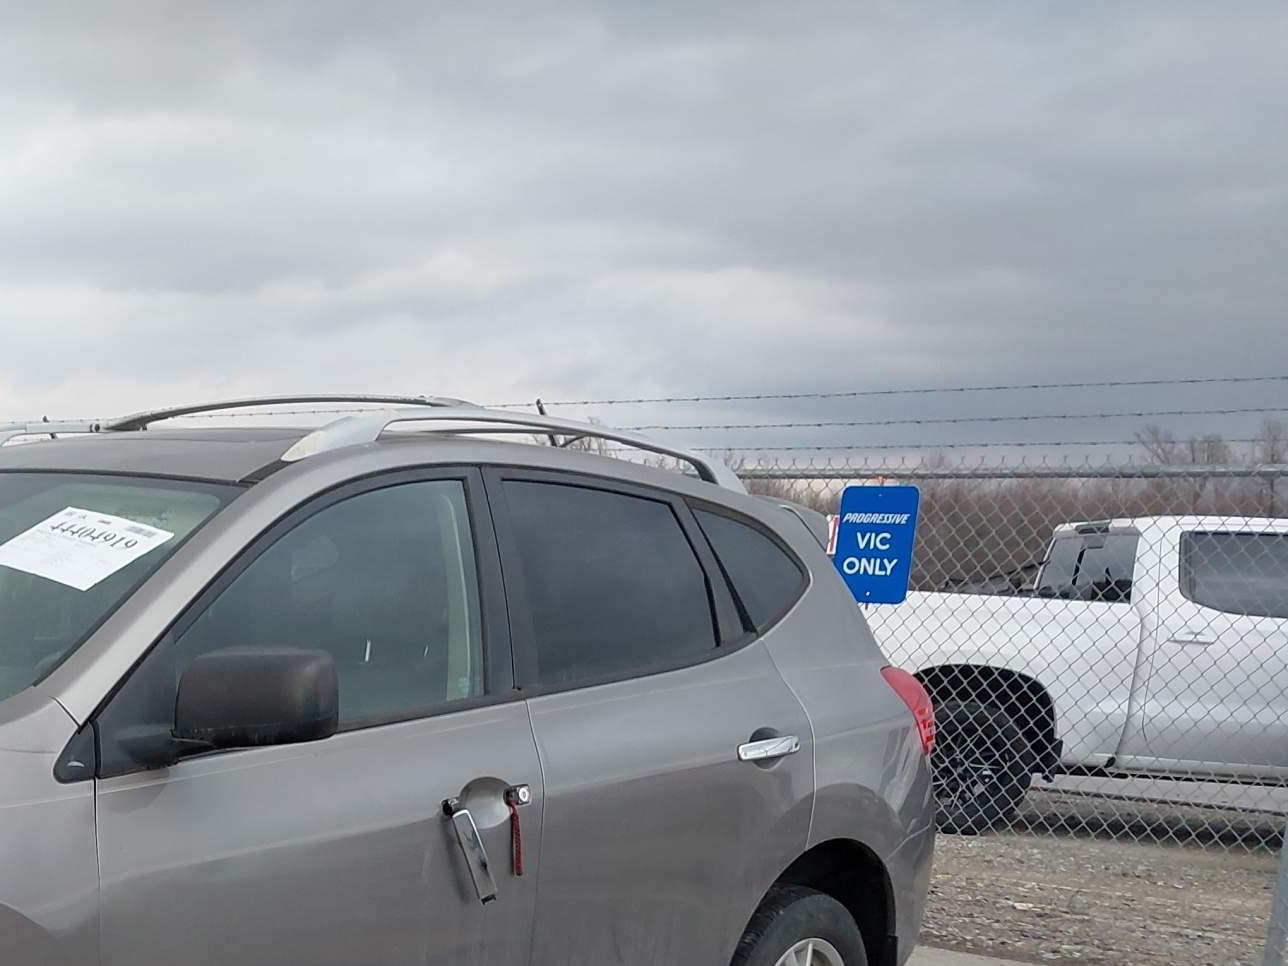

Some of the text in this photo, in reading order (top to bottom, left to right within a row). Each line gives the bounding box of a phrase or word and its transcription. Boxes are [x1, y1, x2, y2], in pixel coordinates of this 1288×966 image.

[842, 512, 910, 524] PROGRESSIVE
[856, 531, 891, 550] VIC
[843, 557, 897, 576] ONLY
